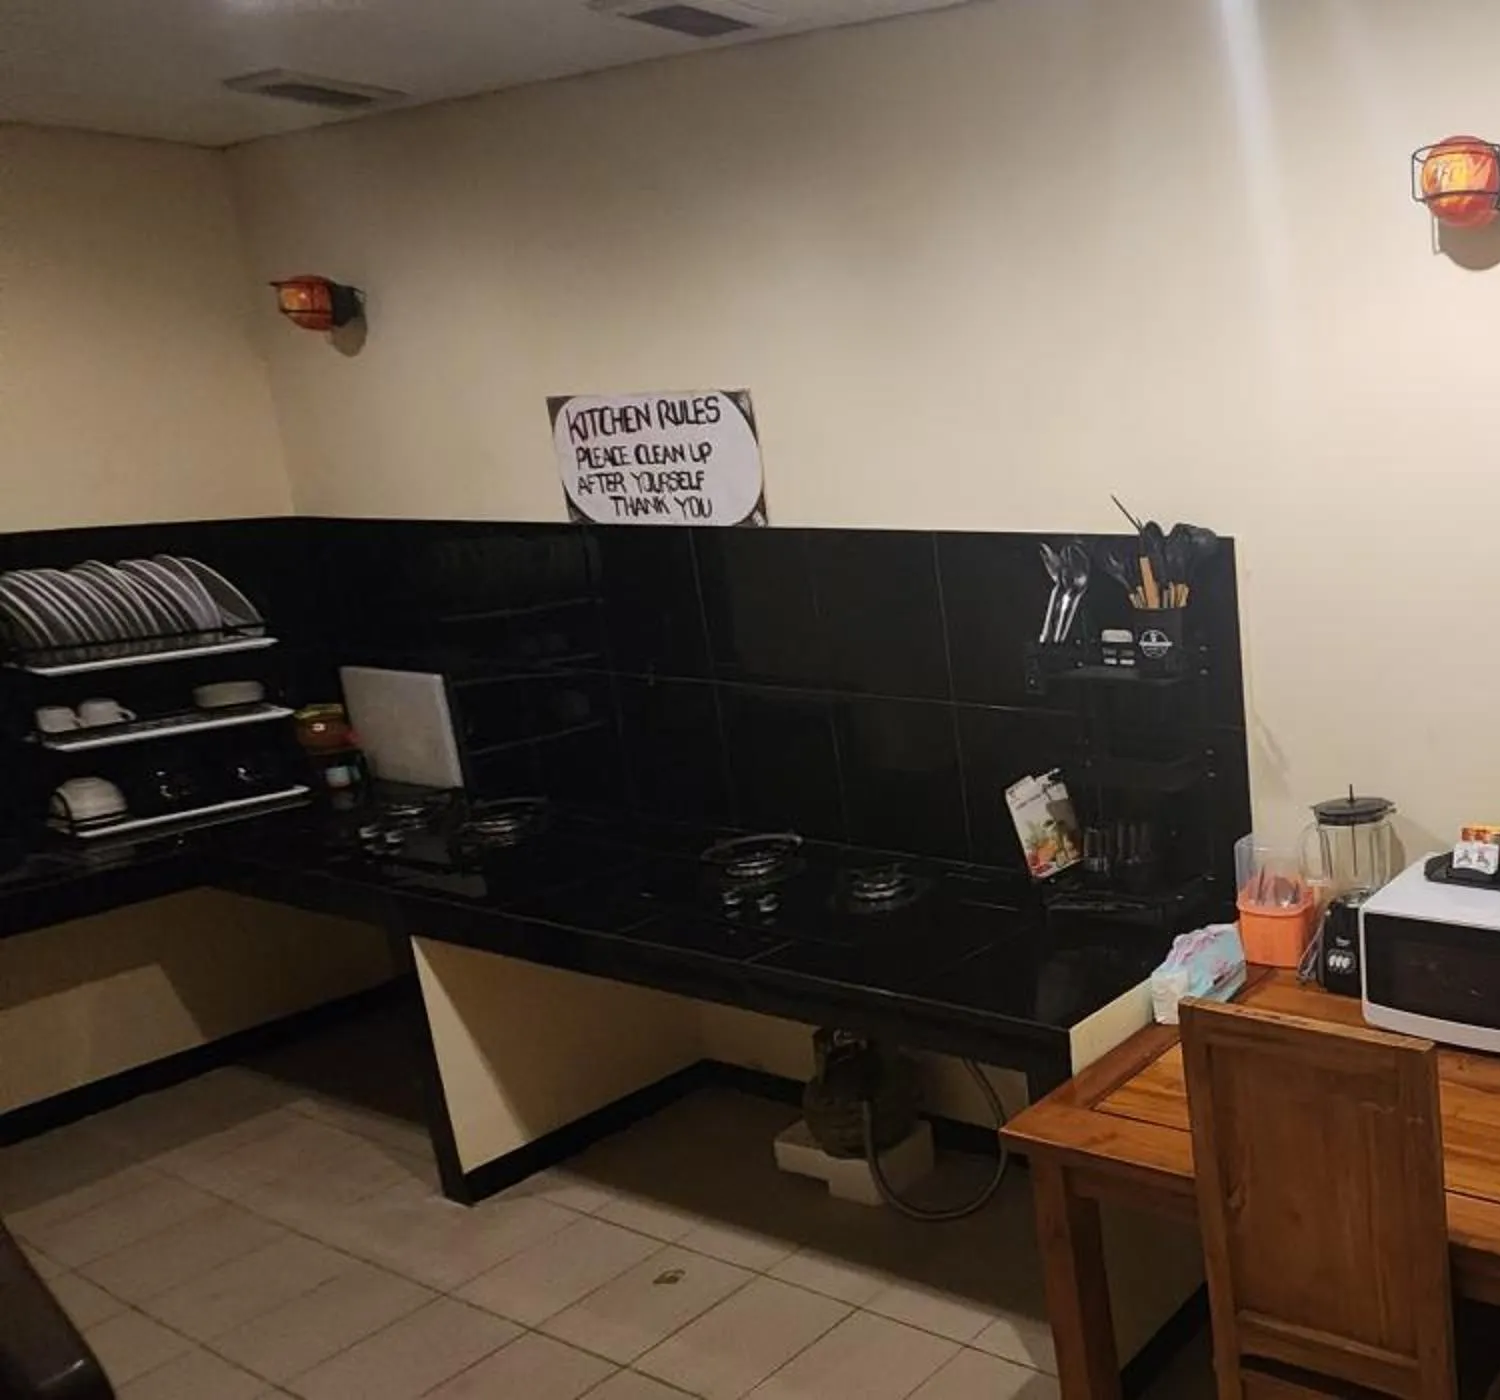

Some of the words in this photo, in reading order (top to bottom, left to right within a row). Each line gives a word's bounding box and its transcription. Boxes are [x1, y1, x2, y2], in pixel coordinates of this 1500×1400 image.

[566, 402, 651, 444] KITCHEN
[657, 396, 721, 430] RULES
[634, 443, 685, 465] CLEAN
[689, 441, 712, 464] UP
[577, 472, 626, 496] AFTER
[631, 471, 705, 494] YOURSELF
[610, 495, 671, 518] THANK
[674, 497, 713, 519] YOU
